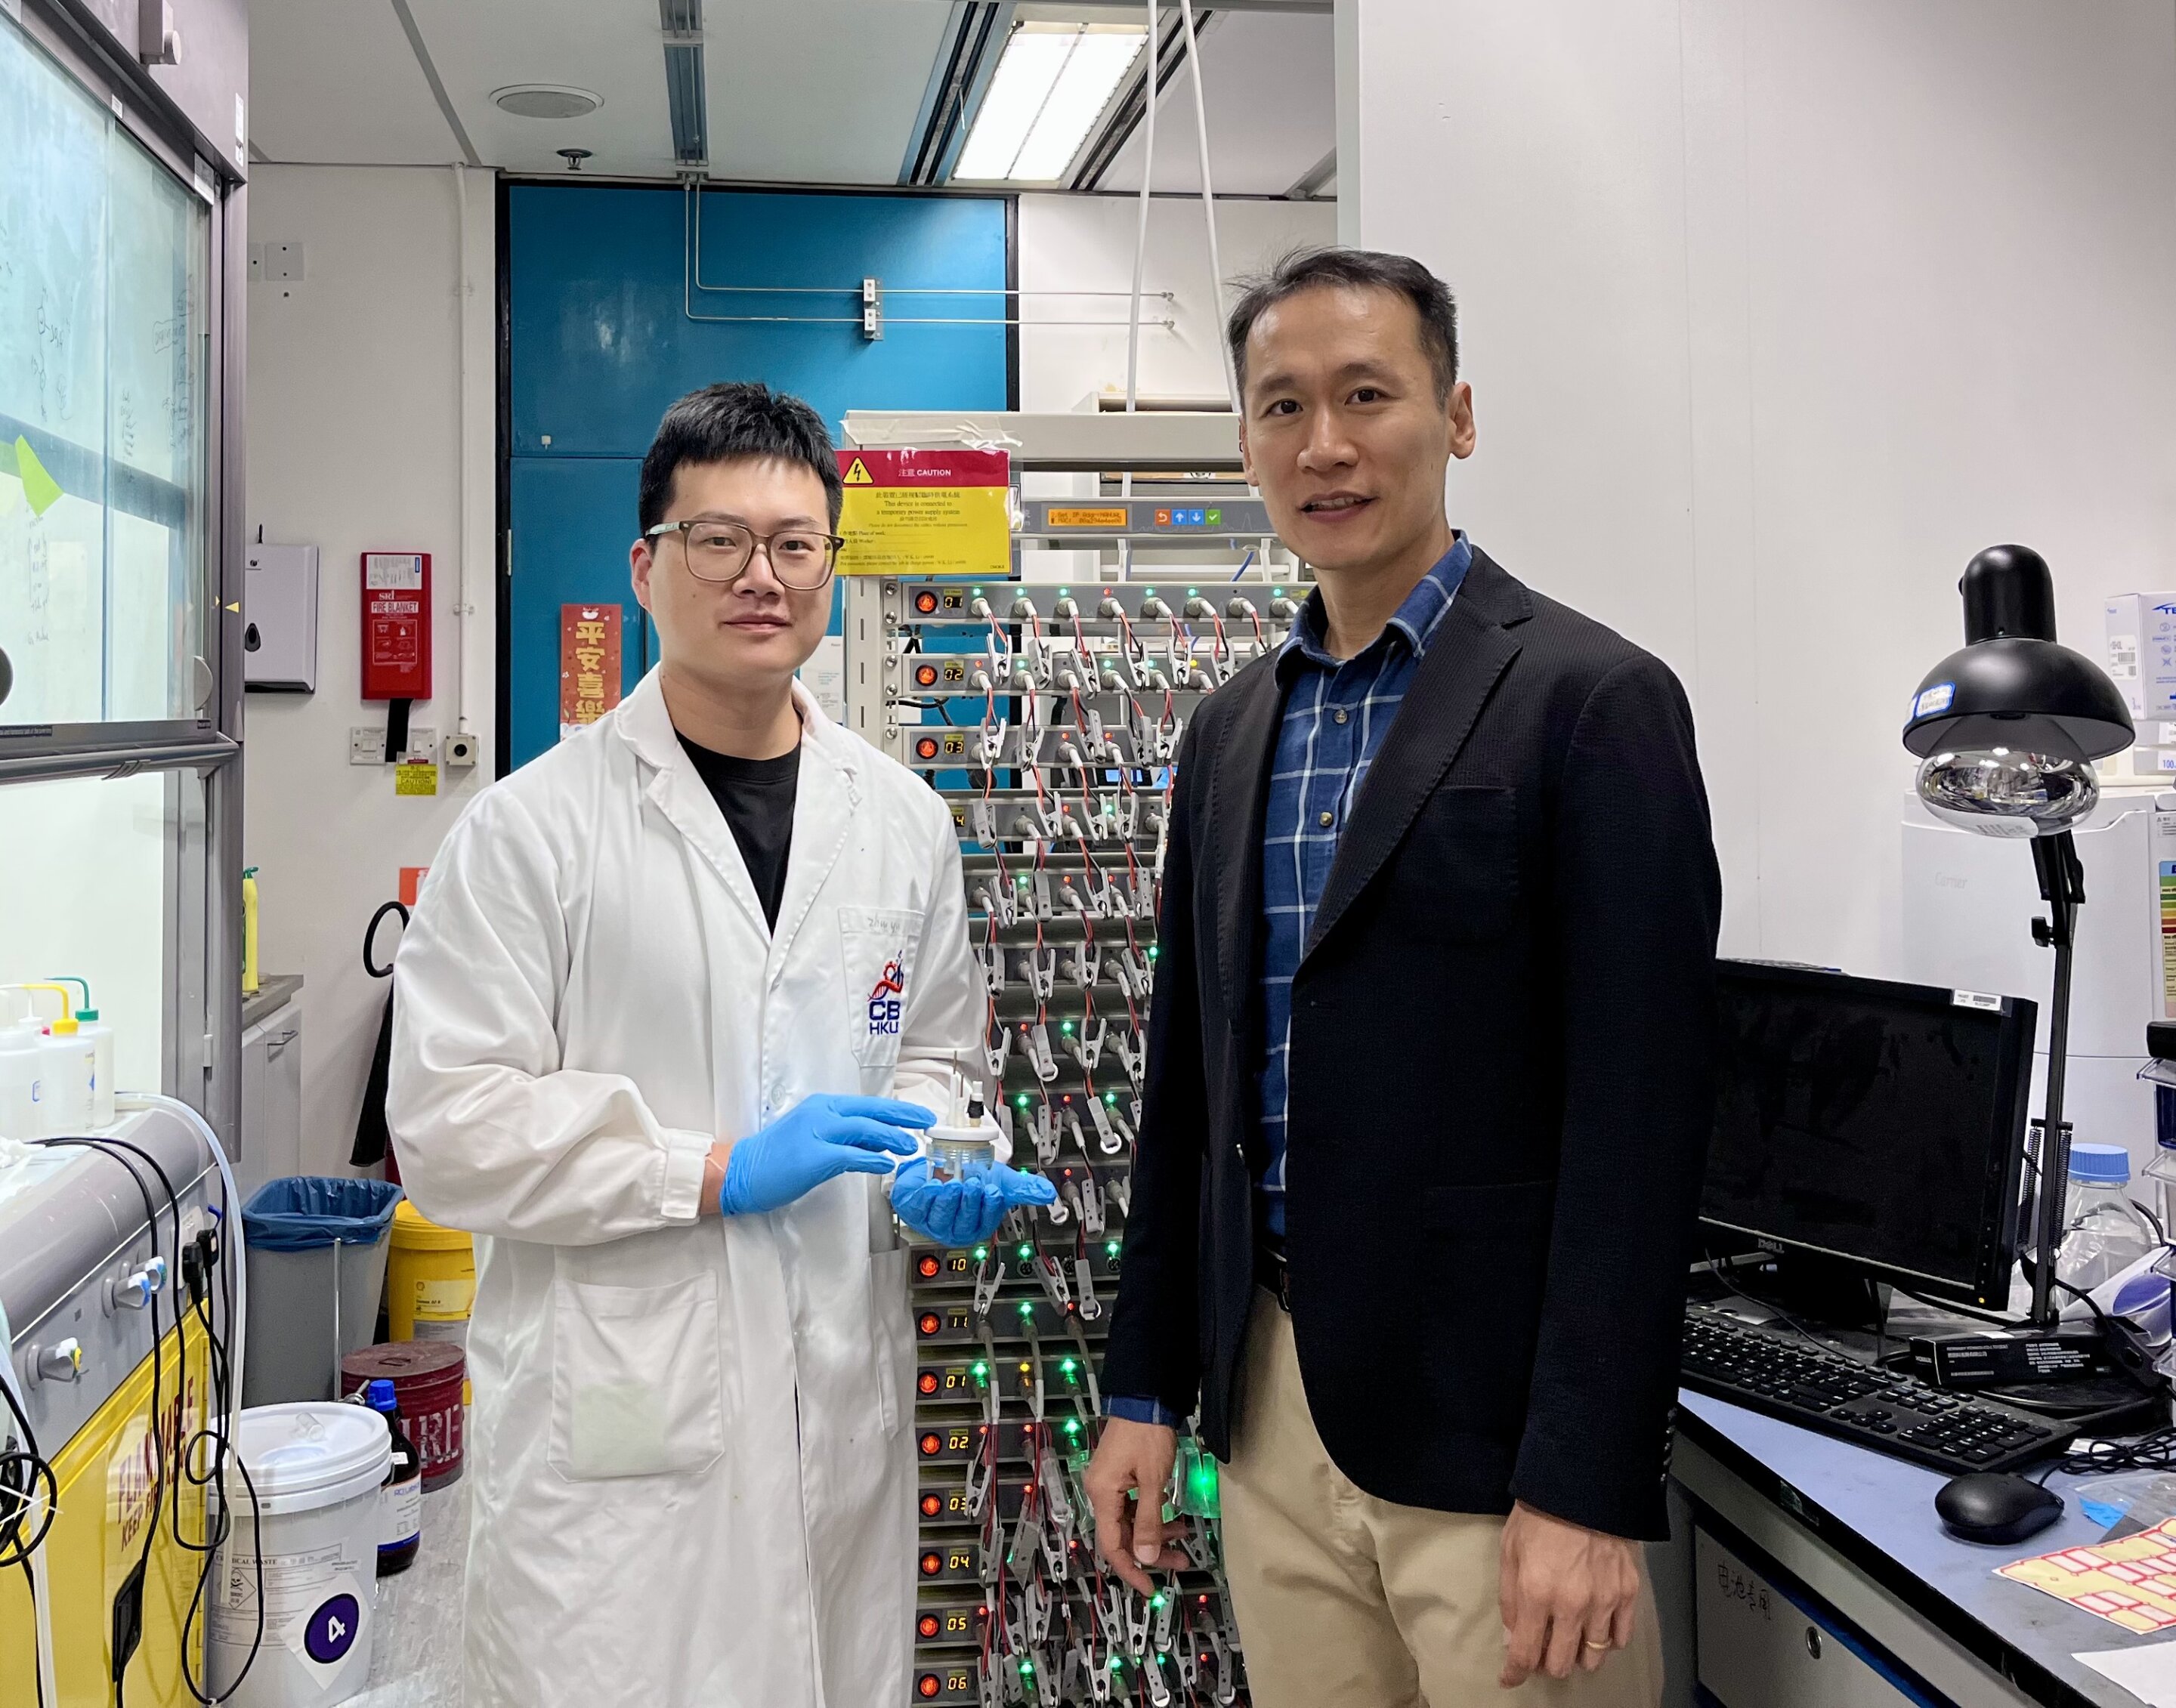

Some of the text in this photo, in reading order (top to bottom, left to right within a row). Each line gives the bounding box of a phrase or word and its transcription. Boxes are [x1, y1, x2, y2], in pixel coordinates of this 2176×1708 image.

[898, 468, 915, 477] 注意
[372, 602, 416, 612] FIRE BLANKET
[944, 596, 963, 608] 01
[944, 669, 963, 681] 02
[945, 741, 963, 754] 03
[870, 1021, 899, 1035] HKU
[1758, 1238, 1785, 1253] DELL
[952, 1258, 966, 1271] 10
[946, 1375, 966, 1388] 01
[122, 1503, 144, 1552] KEEP
[949, 1556, 969, 1569] 04
[328, 1615, 346, 1643] 4
[947, 1617, 966, 1630] 05
[948, 1677, 966, 1690] 06
